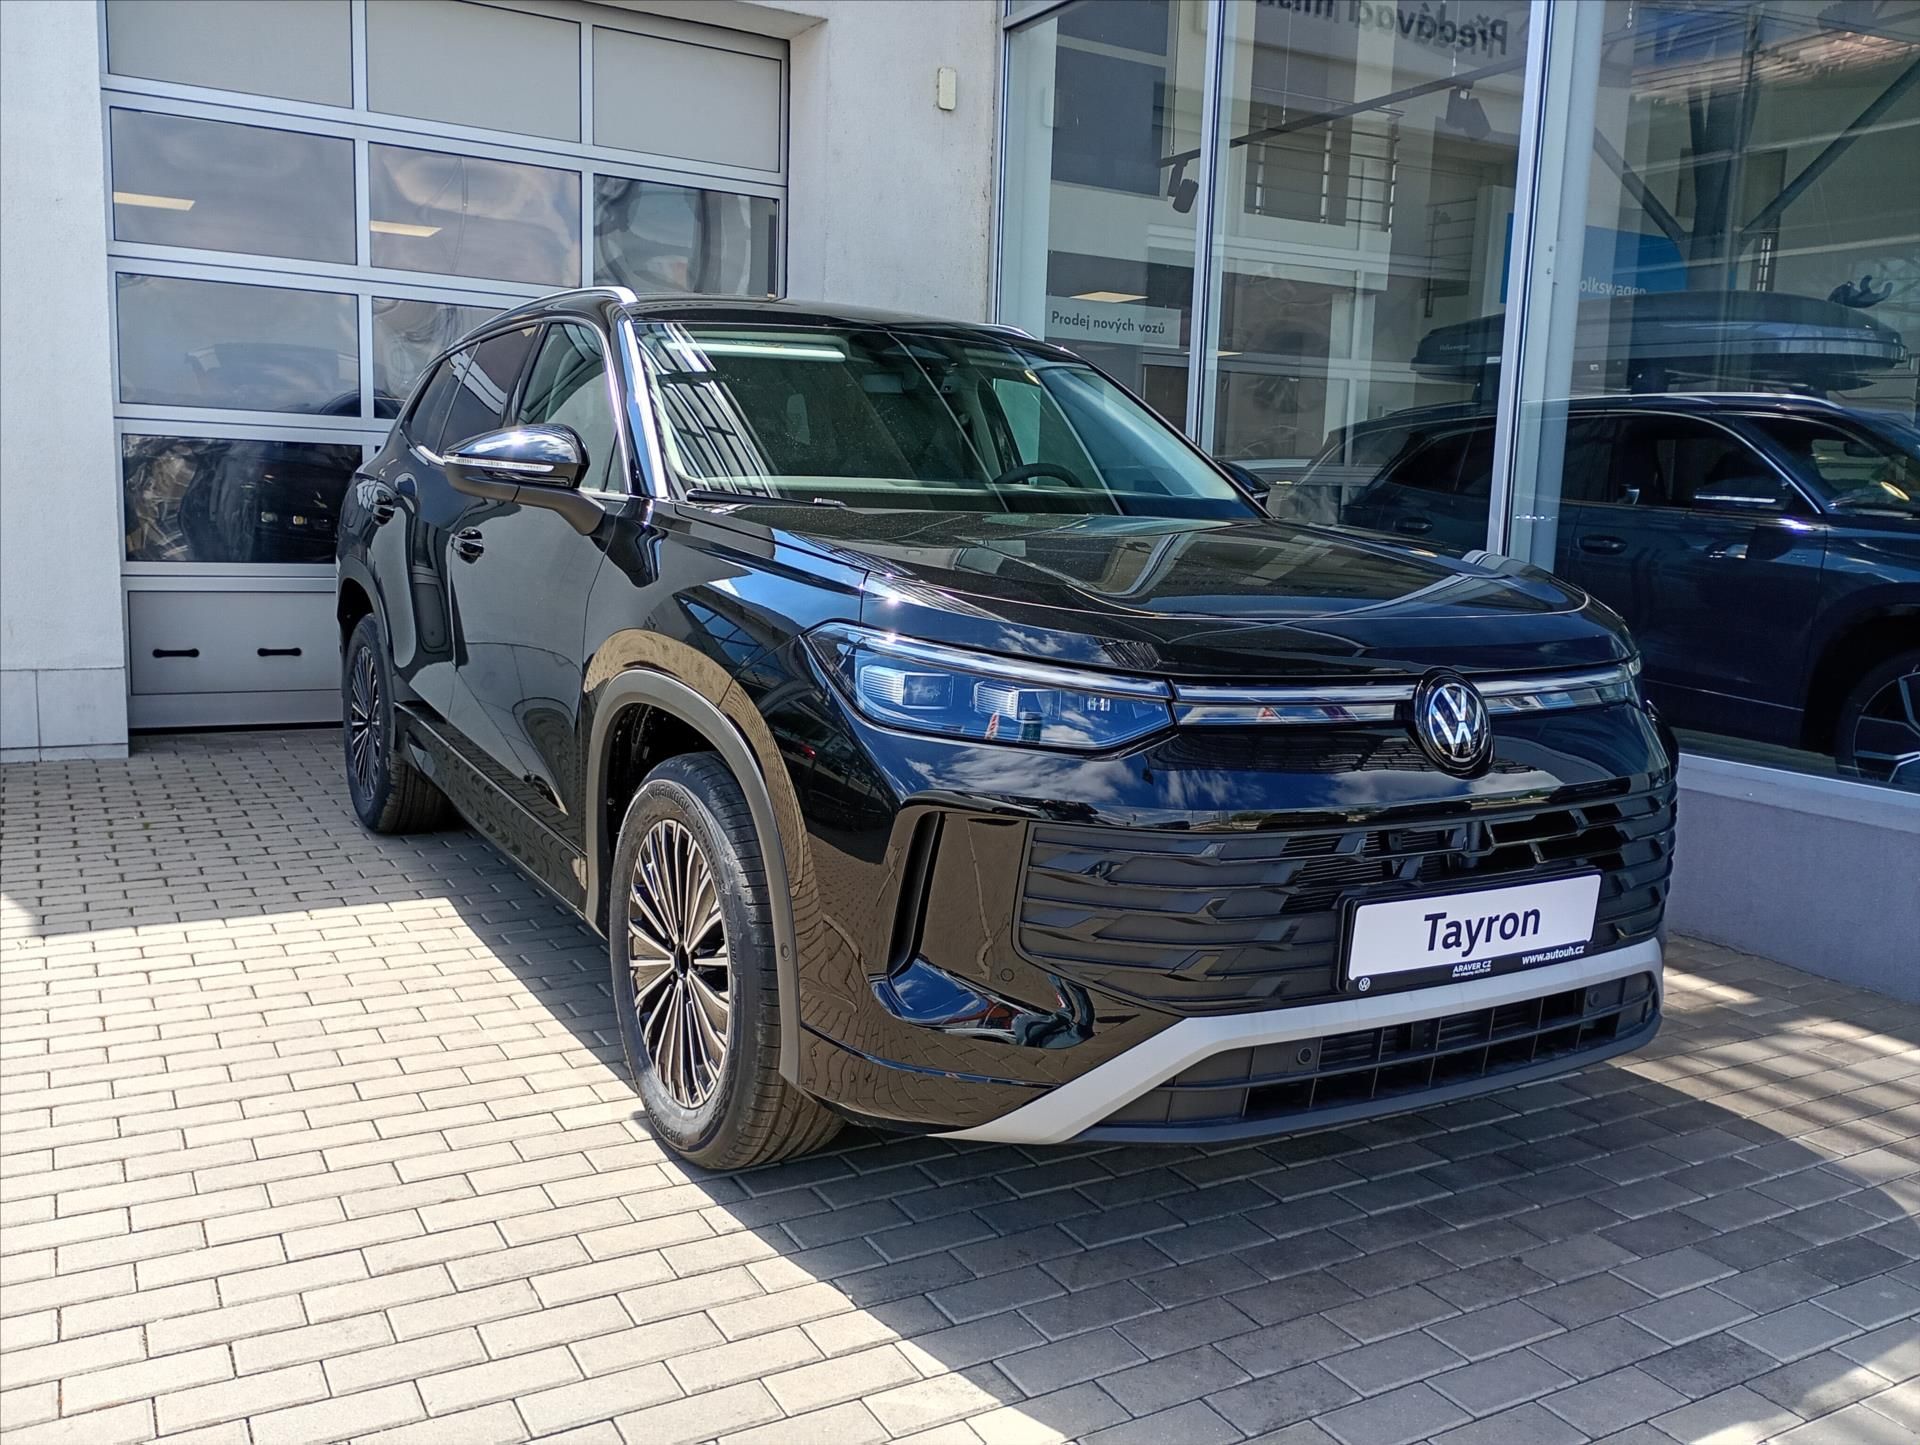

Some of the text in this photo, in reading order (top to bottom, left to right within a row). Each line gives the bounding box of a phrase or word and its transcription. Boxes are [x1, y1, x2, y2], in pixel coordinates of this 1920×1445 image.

[1579, 276, 1647, 296] olkswagen
[1051, 310, 1166, 334] Prodej nových vozů
[1423, 907, 1541, 957] Tayron
[1521, 945, 1585, 965] www.autouh.cz
[1453, 962, 1482, 973] ARAVER
